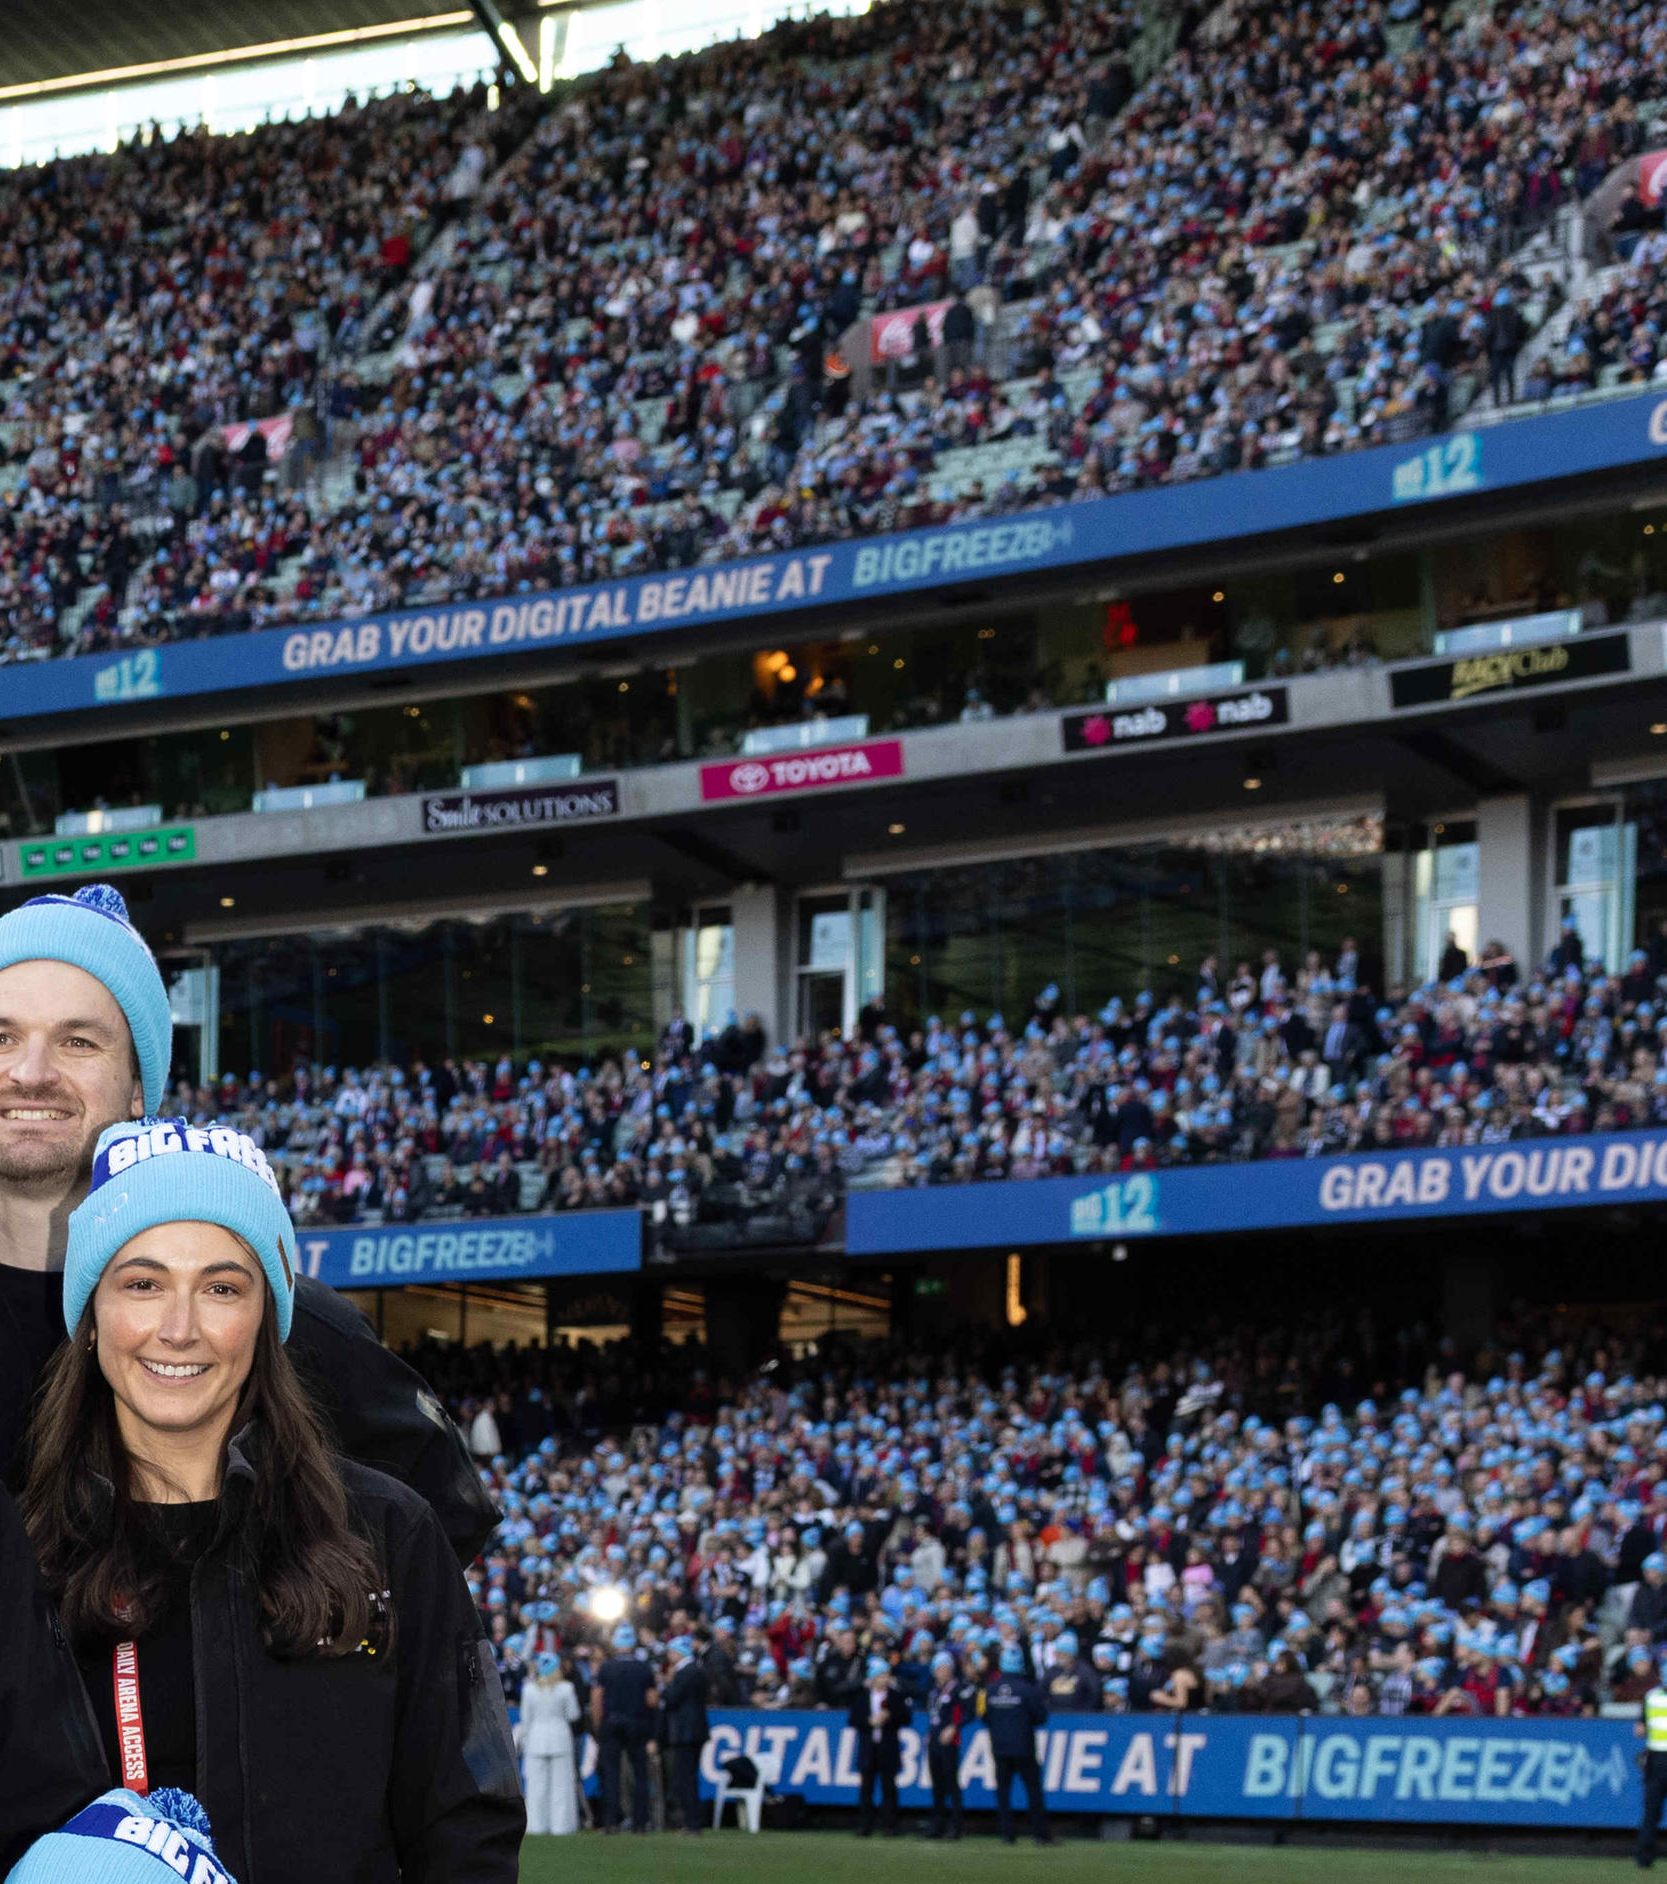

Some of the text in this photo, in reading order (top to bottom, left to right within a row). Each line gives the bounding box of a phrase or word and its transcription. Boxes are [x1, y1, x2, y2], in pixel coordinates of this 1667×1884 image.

[283, 625, 380, 671] GRAB
[387, 612, 484, 657] YOUR
[489, 588, 630, 645] DIGITAL
[637, 560, 775, 622] BEANIE
[776, 554, 833, 600] AT
[1112, 707, 1167, 739] nab
[1217, 693, 1273, 725] nab
[770, 751, 872, 786] TOYOTA
[108, 1123, 183, 1177] BIG
[1319, 1147, 1595, 1211] GRAB YOUR
[1104, 1173, 1157, 1233] 12
[116, 1641, 144, 1780] DAILY ARENA ACCESS
[1110, 1733, 1205, 1796] AT
[114, 1815, 190, 1881] BIG
